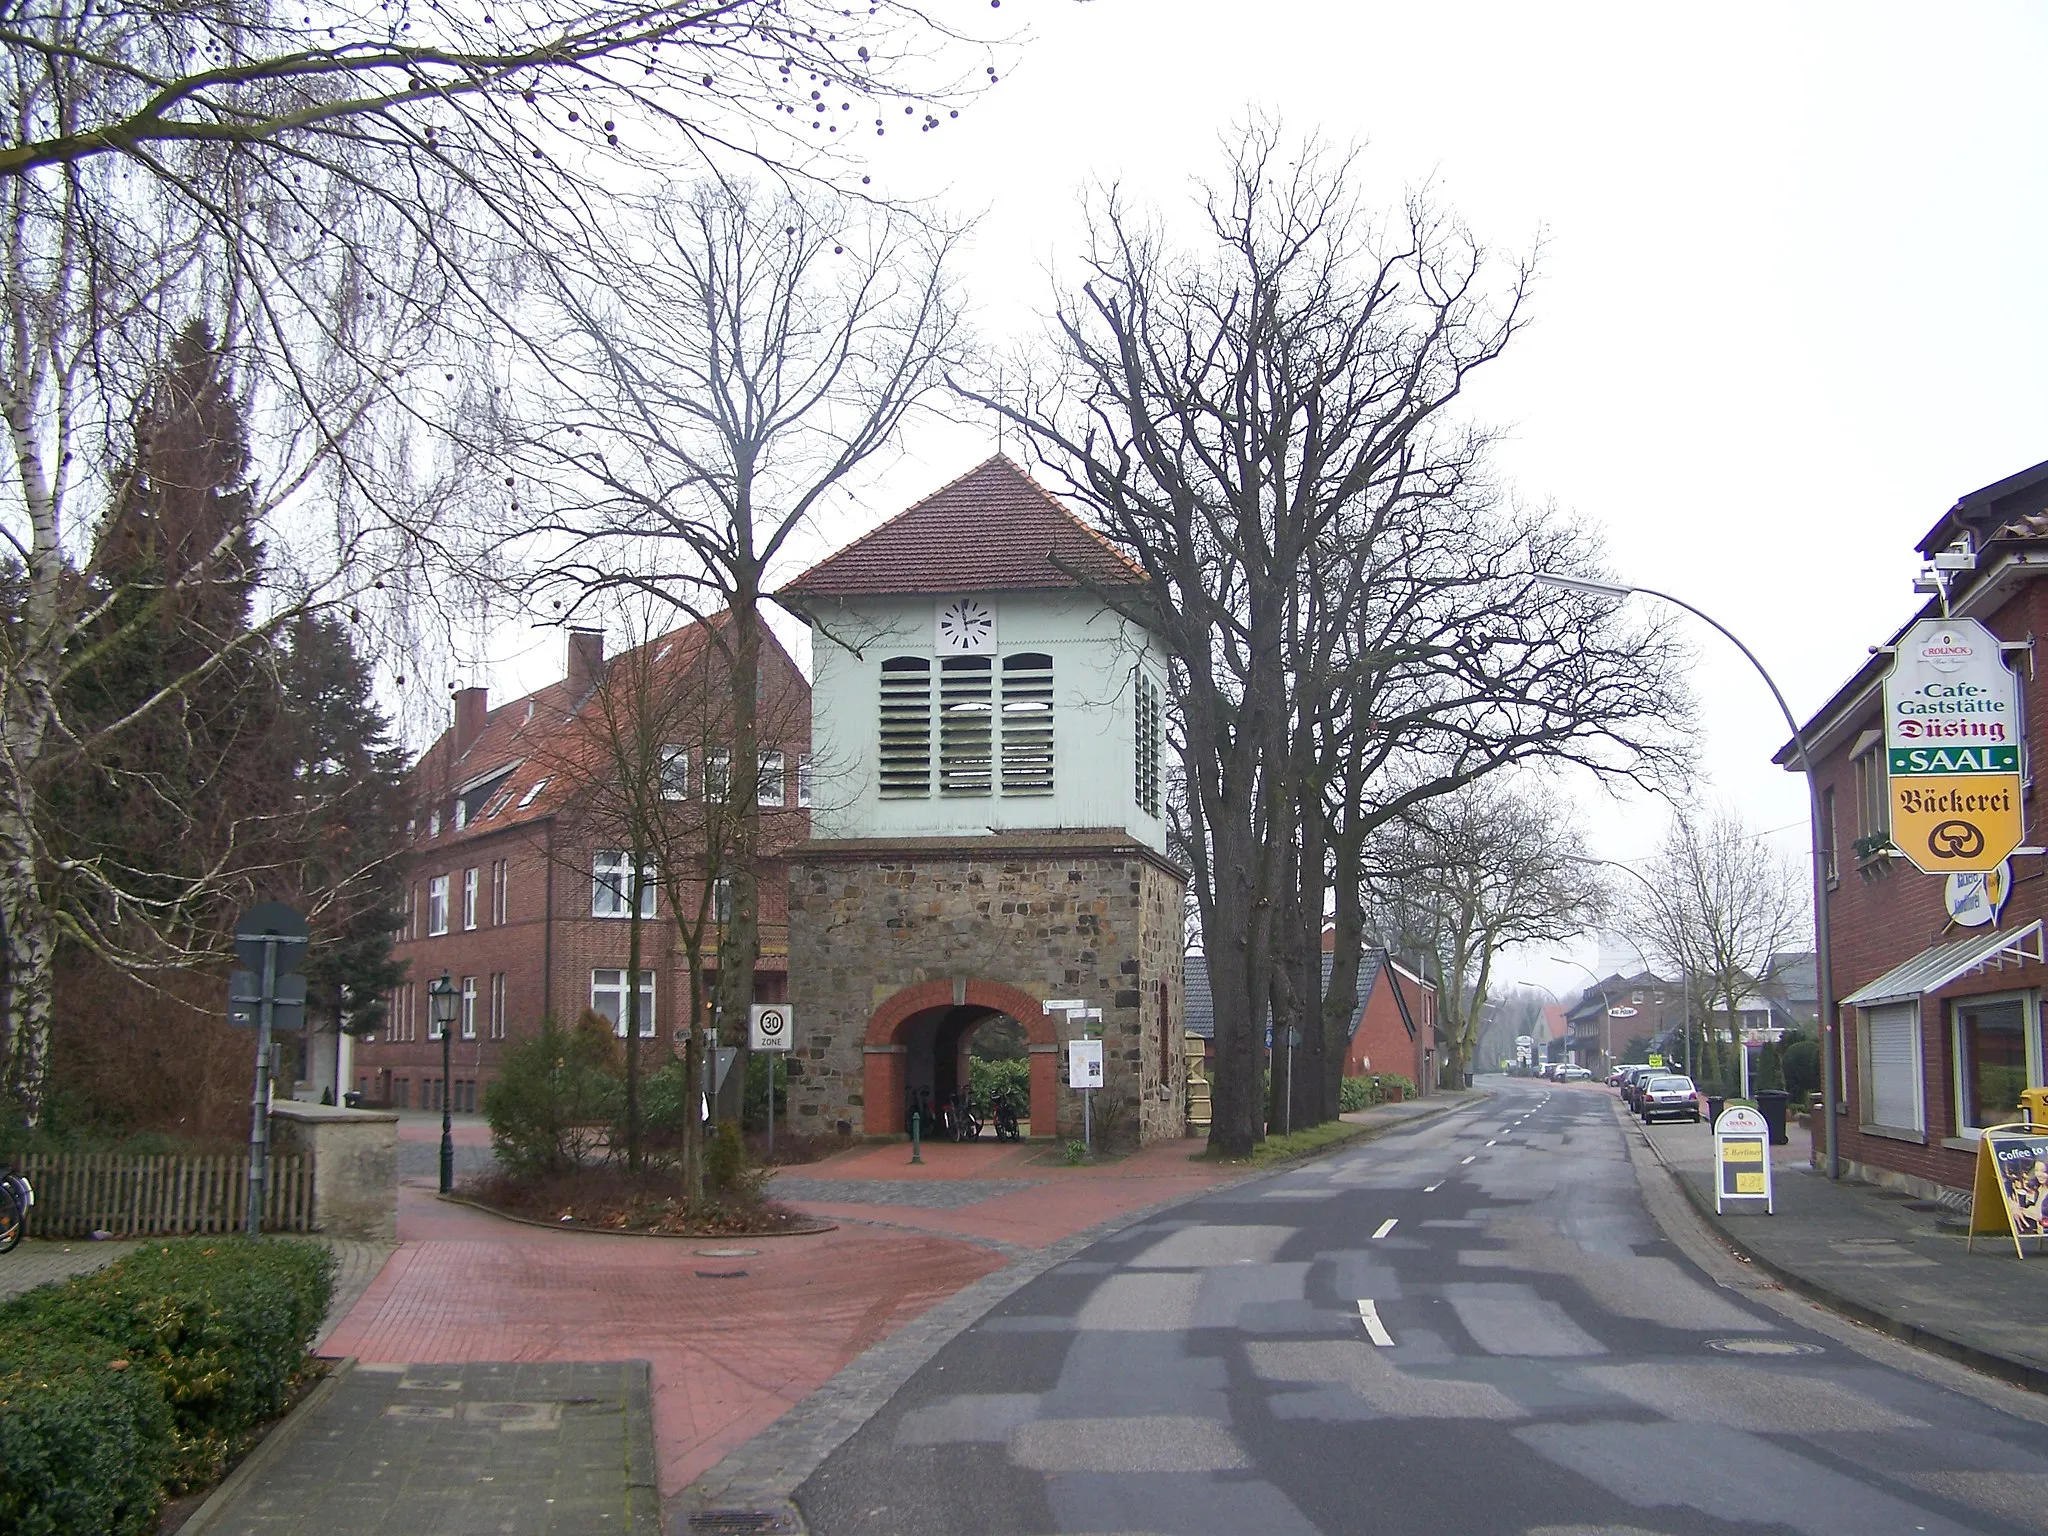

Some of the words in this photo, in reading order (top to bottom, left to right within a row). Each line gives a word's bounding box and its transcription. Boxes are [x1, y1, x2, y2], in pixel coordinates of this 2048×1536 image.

[1928, 647, 1968, 655] ROLINCK
[1924, 682, 1979, 698] Cafe
[1897, 700, 2005, 715] Gaststätte
[1898, 719, 2006, 742] Düsing
[1909, 749, 2001, 772] SAAL
[1900, 788, 2010, 814] Bäckerei
[765, 1016, 779, 1029] 30
[761, 1038, 782, 1046] ZONE
[1999, 1149, 2030, 1160] Coffee
[2032, 1147, 2043, 1156] to
